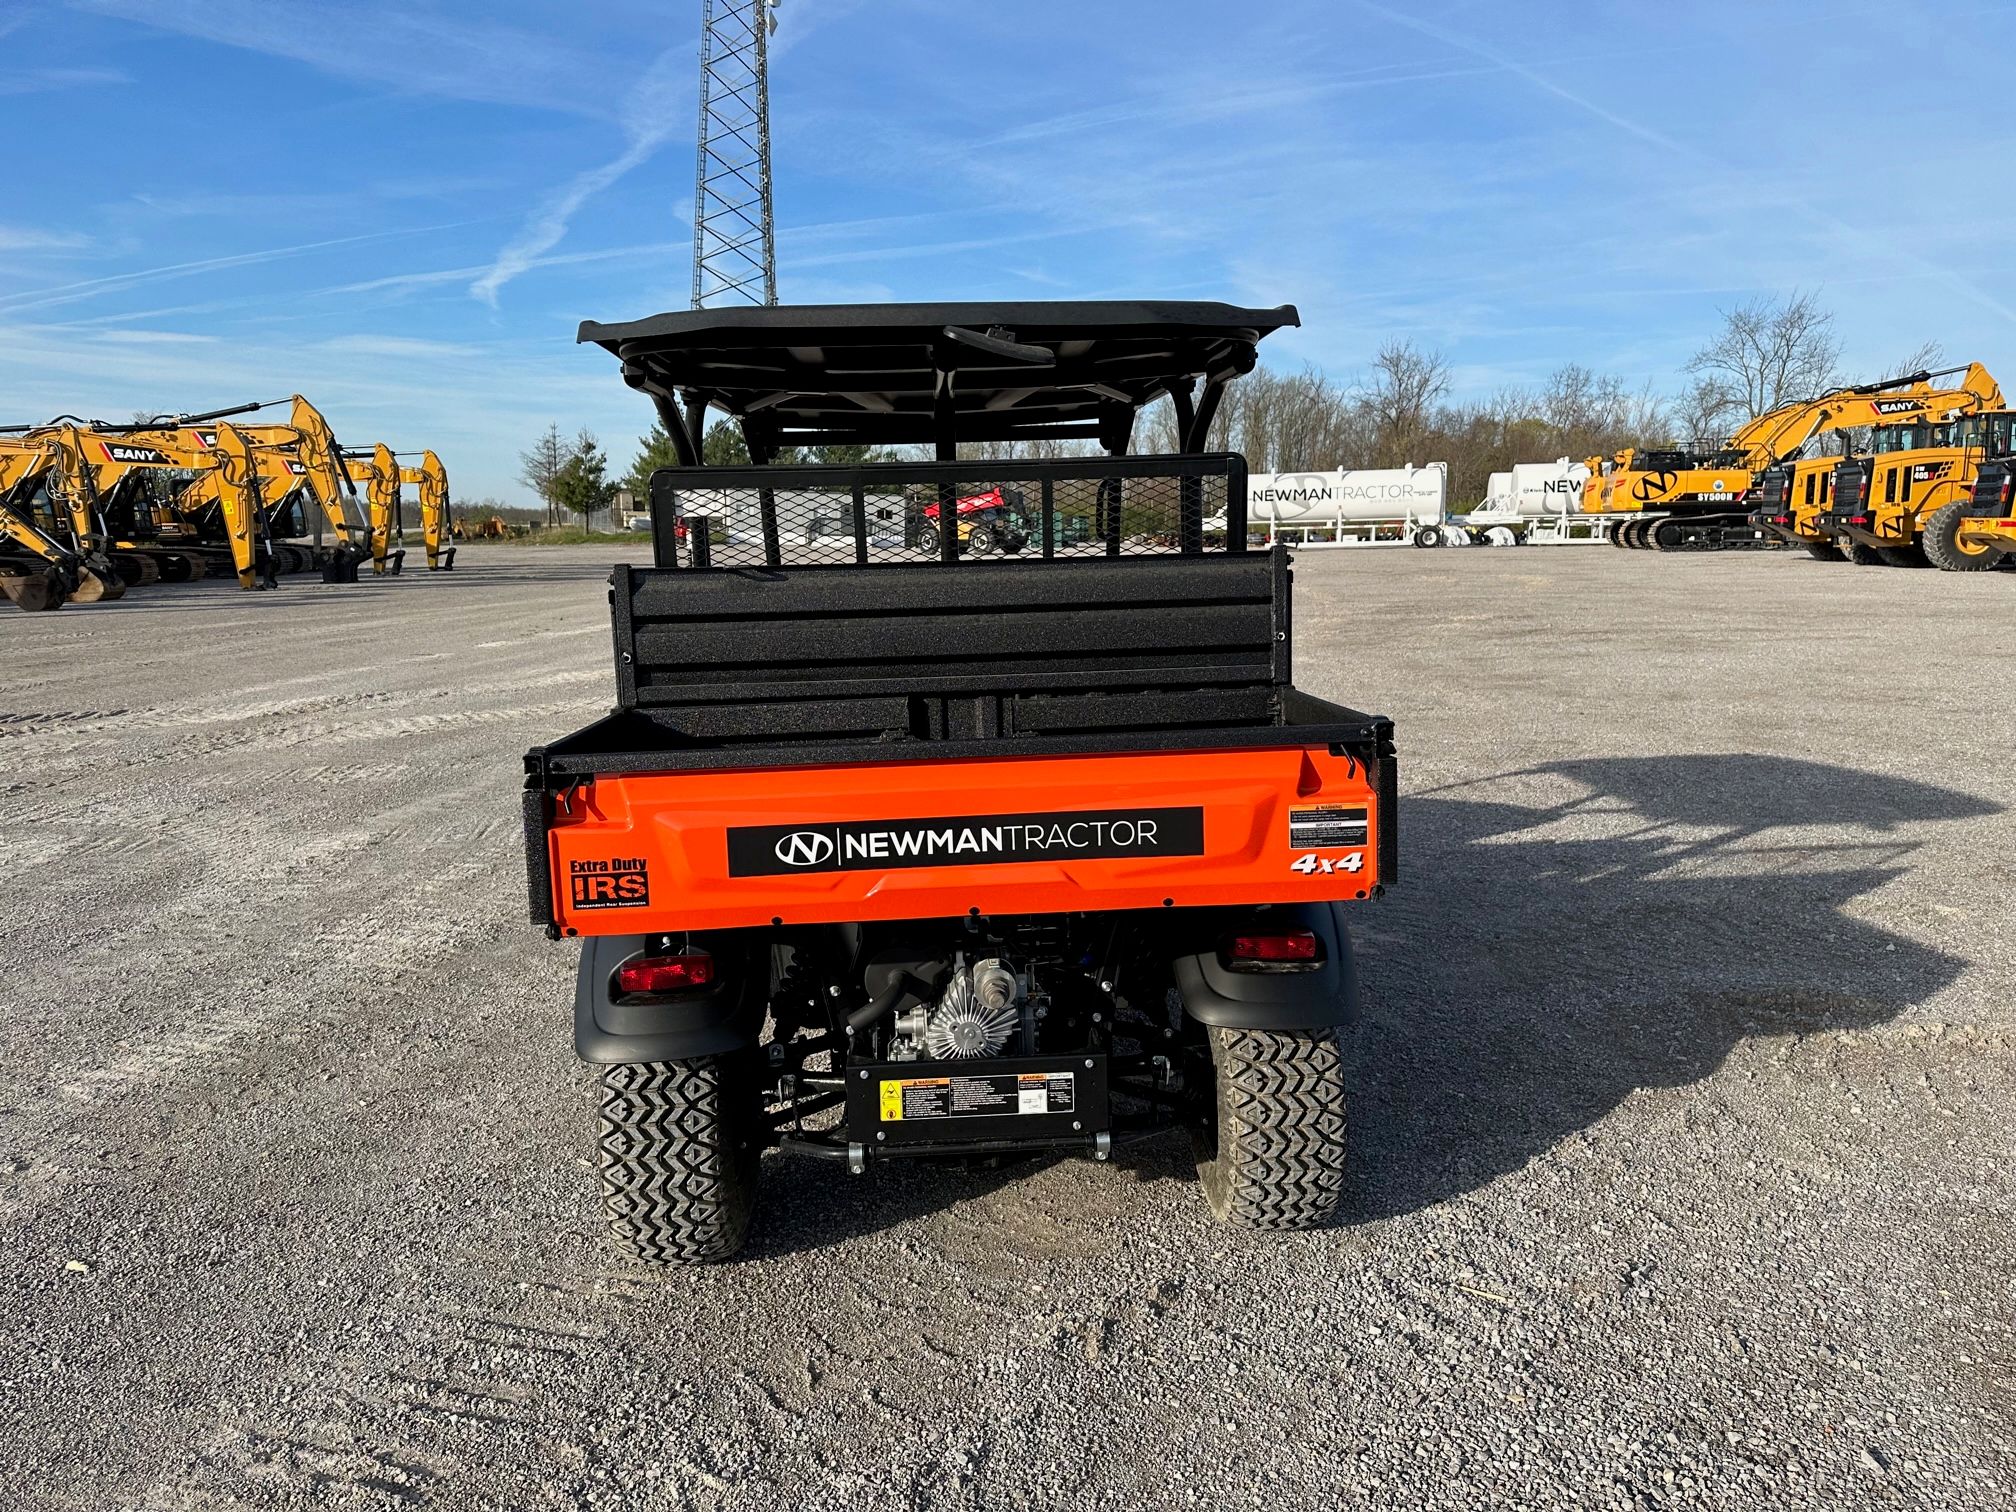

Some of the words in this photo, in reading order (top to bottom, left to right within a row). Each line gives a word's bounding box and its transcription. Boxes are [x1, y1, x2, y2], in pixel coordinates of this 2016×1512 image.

[1880, 401, 1914, 412] SANY
[113, 448, 156, 460] SANY
[292, 464, 306, 472] SA
[1253, 484, 1414, 501] NEWMANTRACTOR
[1697, 492, 1733, 501] SY500H
[845, 820, 1158, 859] NEWMANTRACTOR
[570, 860, 608, 873] Extra
[611, 858, 647, 872] Duty
[1290, 852, 1364, 875] 4x4
[574, 875, 647, 900] IRS
